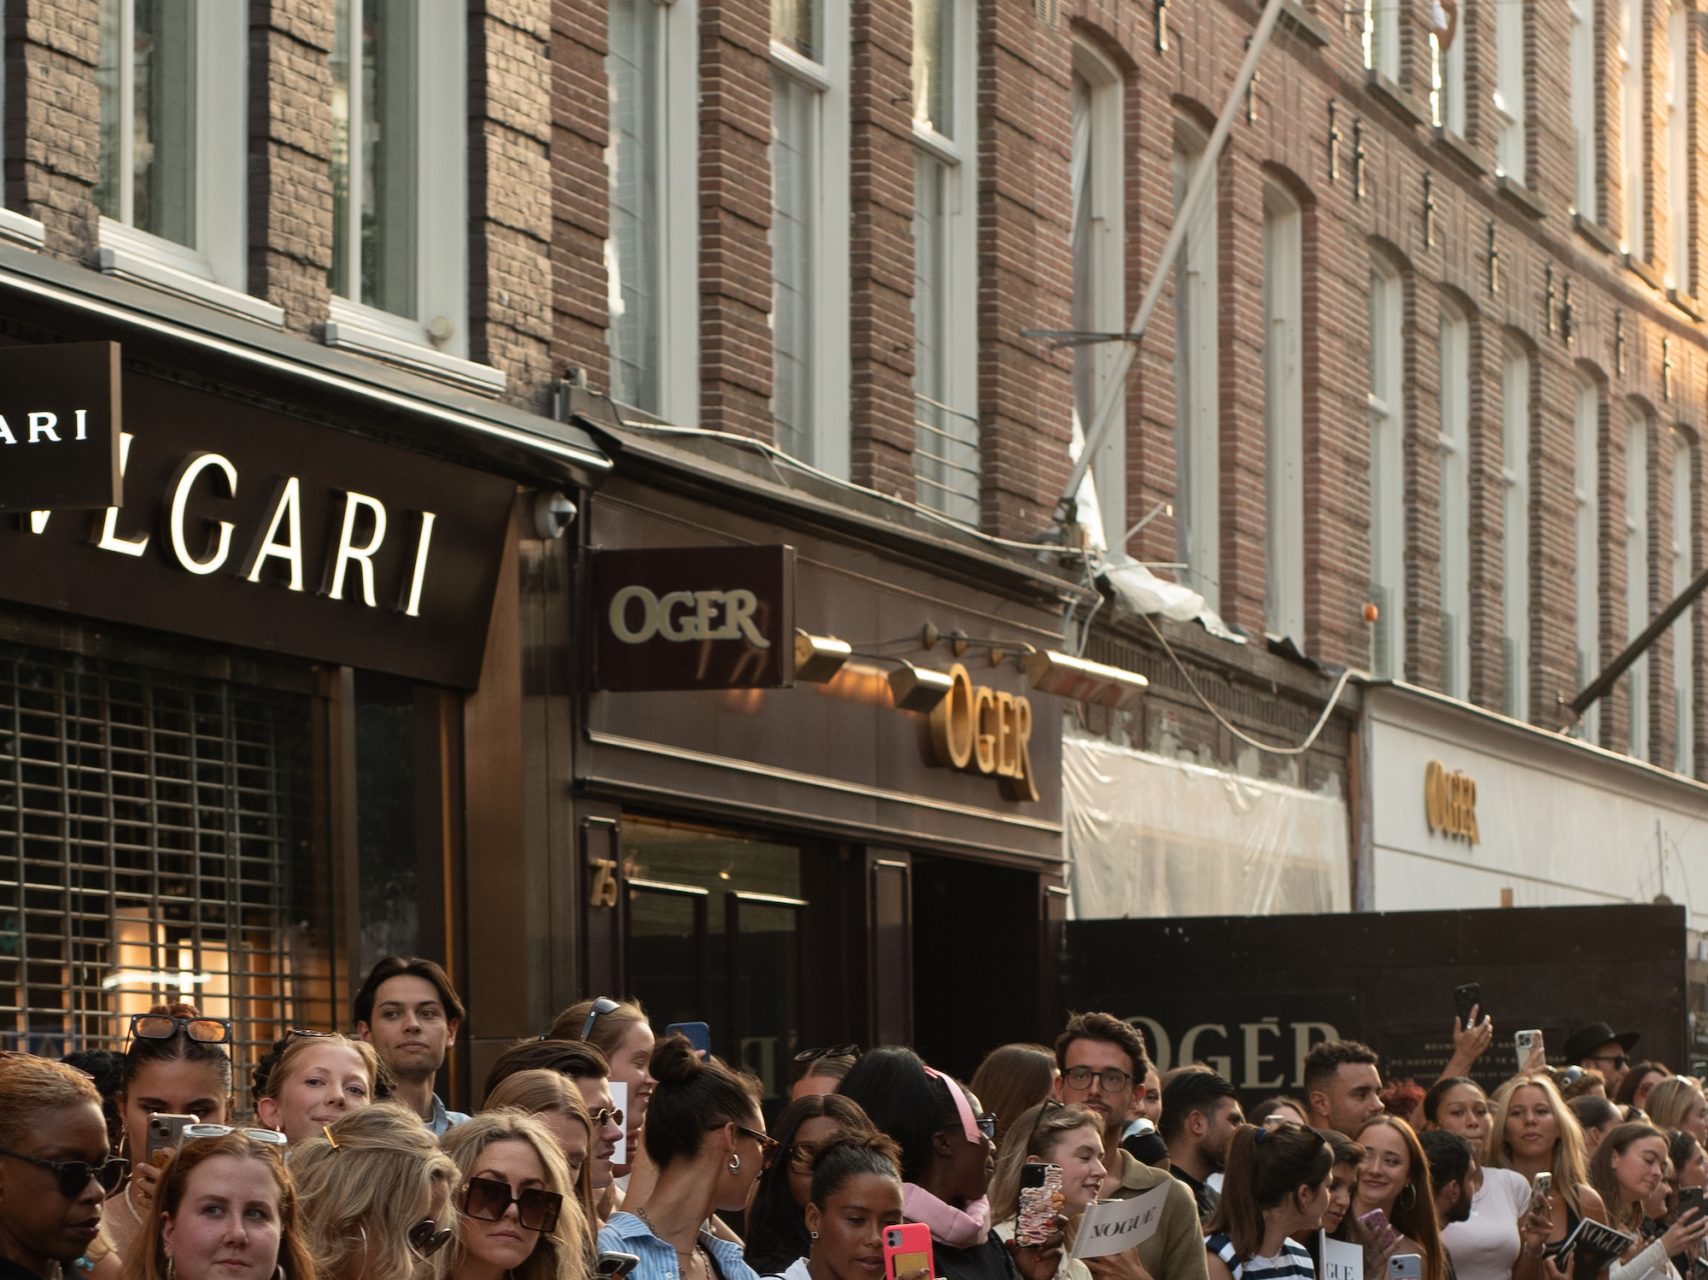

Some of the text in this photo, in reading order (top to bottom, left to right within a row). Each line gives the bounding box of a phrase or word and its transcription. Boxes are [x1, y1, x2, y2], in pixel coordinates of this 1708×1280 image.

[31, 432, 437, 617] LGARI
[609, 585, 771, 649] OGER
[944, 662, 1041, 802] OGER
[1089, 1206, 1156, 1239] VOGUE
